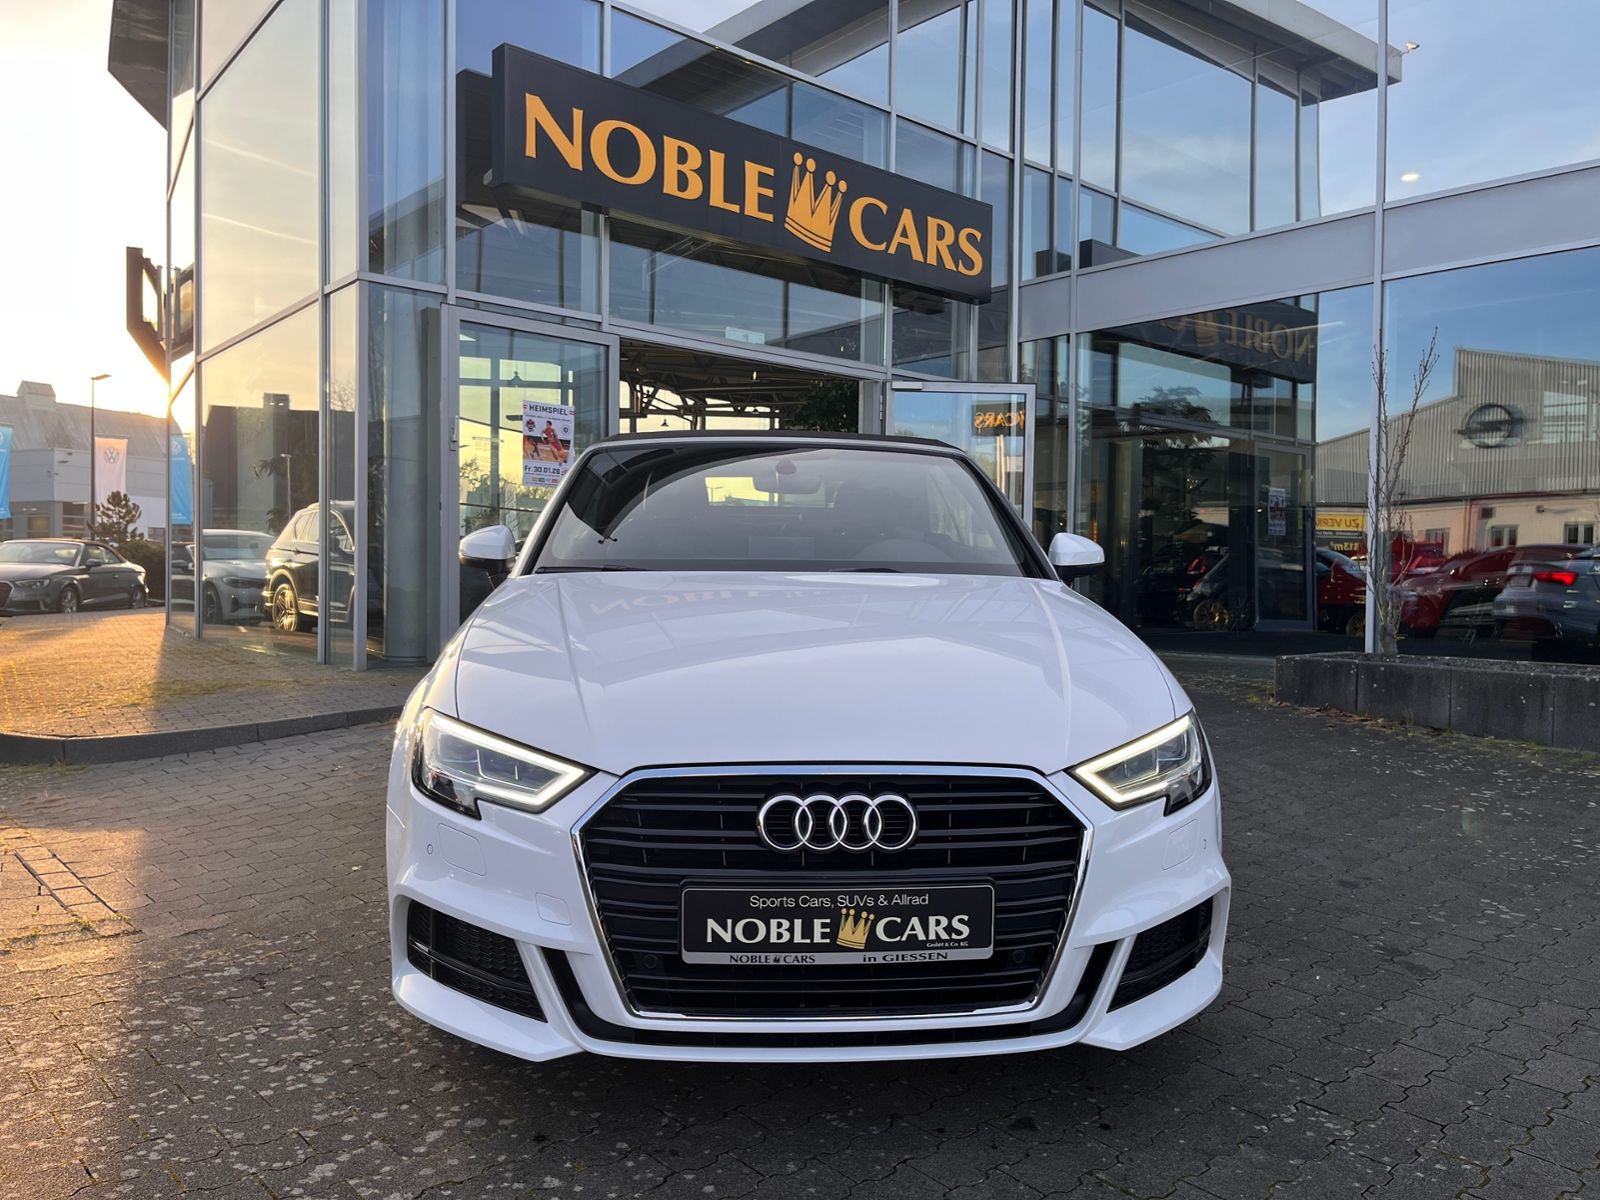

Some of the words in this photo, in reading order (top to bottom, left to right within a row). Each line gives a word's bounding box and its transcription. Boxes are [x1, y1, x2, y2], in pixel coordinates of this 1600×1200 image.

[524, 92, 775, 222] NOBLE
[849, 196, 984, 277] CARS
[529, 404, 567, 415] HEIMSPIEL
[749, 895, 796, 909] Sports
[799, 895, 835, 908] Cars,
[836, 894, 875, 907] SUVs
[877, 895, 888, 905] &
[891, 893, 929, 905] Allrad
[706, 918, 831, 944] NOBLE
[875, 914, 971, 942] CARS
[729, 955, 771, 964] NOBLE
[783, 954, 816, 964] CARS
[863, 954, 877, 963] in
[882, 952, 948, 963] GIESSEN
